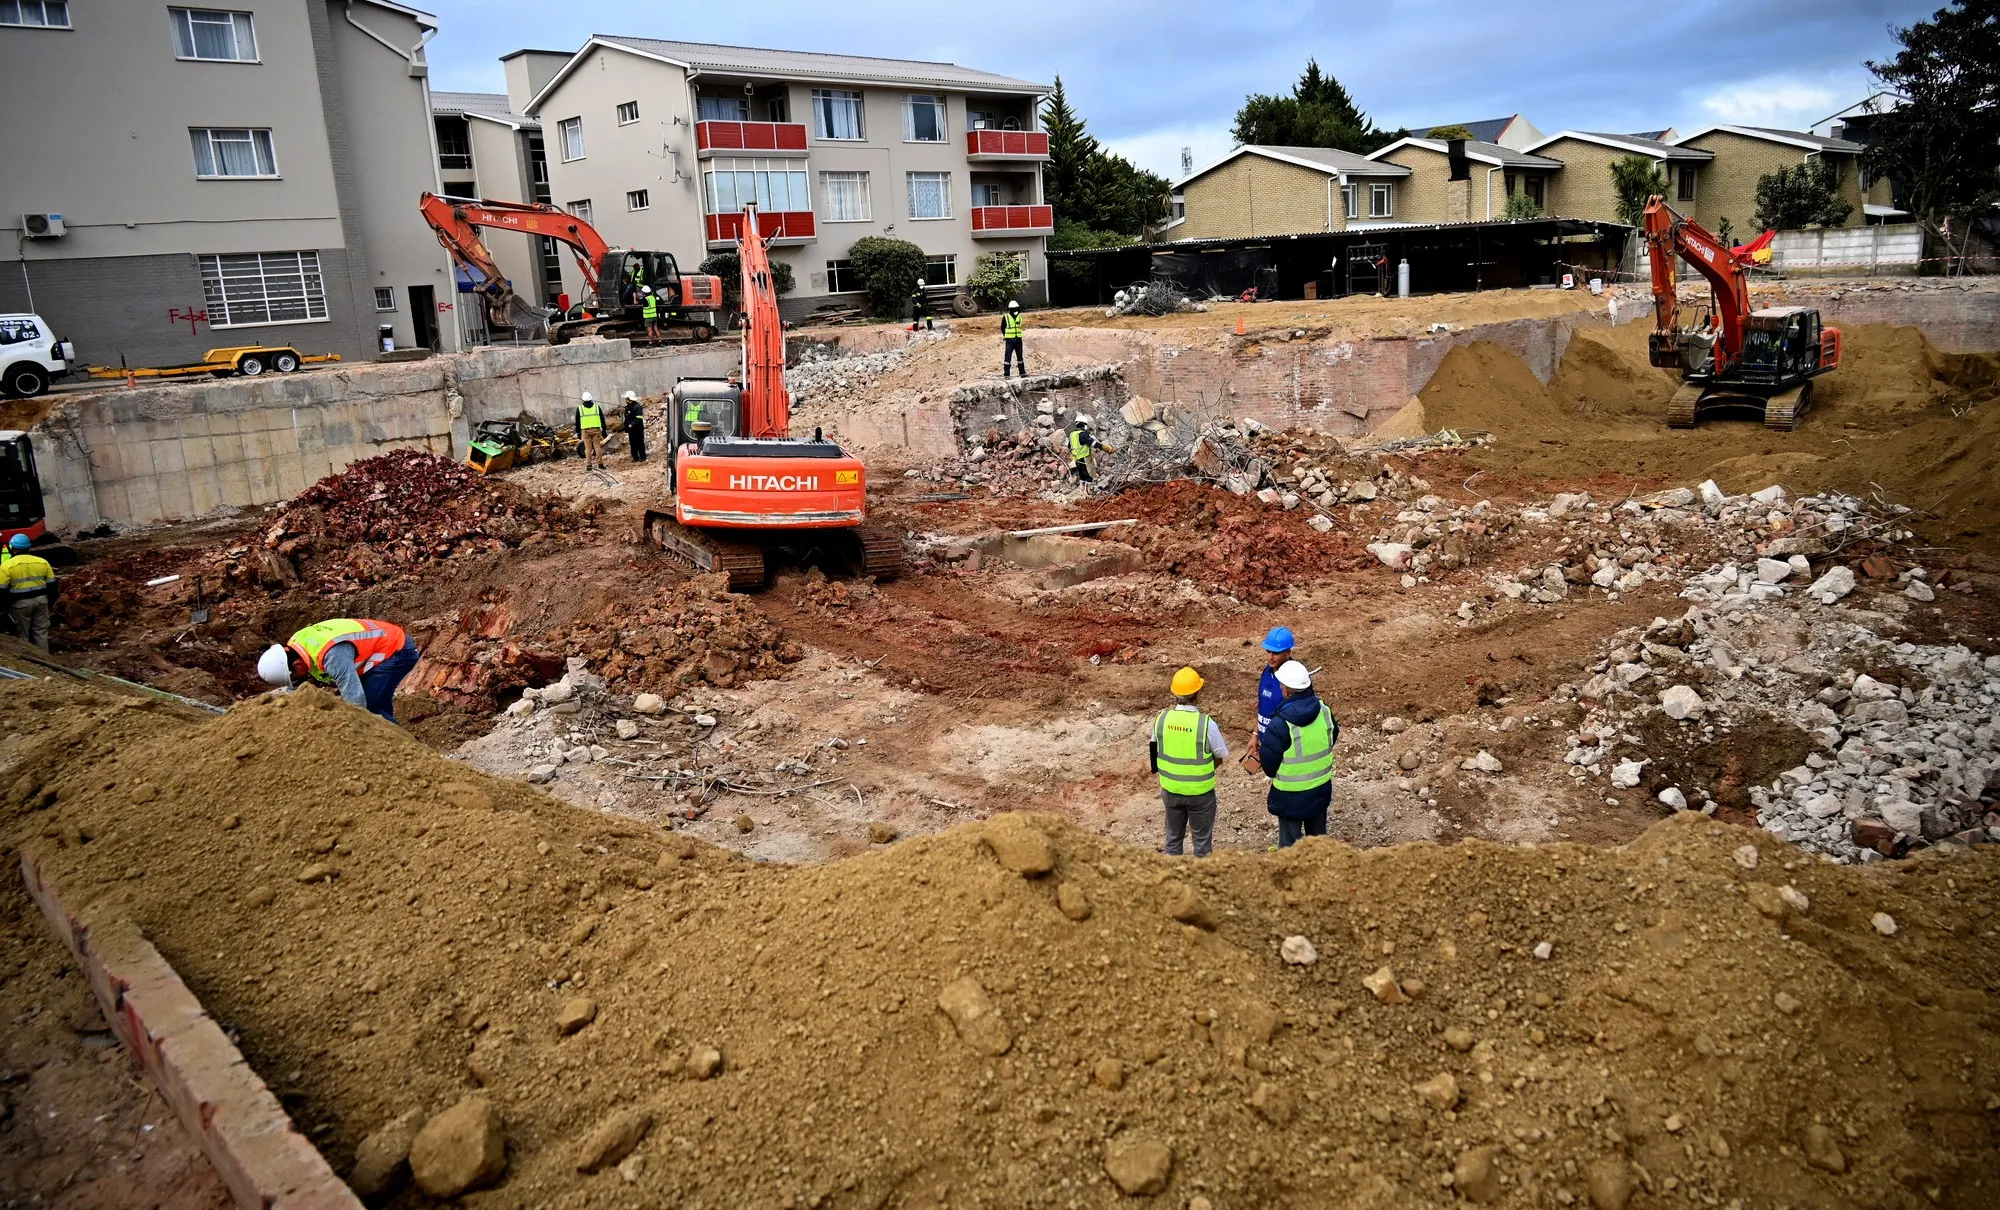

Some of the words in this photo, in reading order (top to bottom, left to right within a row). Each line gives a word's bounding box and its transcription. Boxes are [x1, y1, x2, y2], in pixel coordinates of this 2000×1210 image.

[482, 213, 518, 225] HITACHI
[1685, 234, 1705, 255] HITACHI
[729, 474, 818, 491] HITACHI
